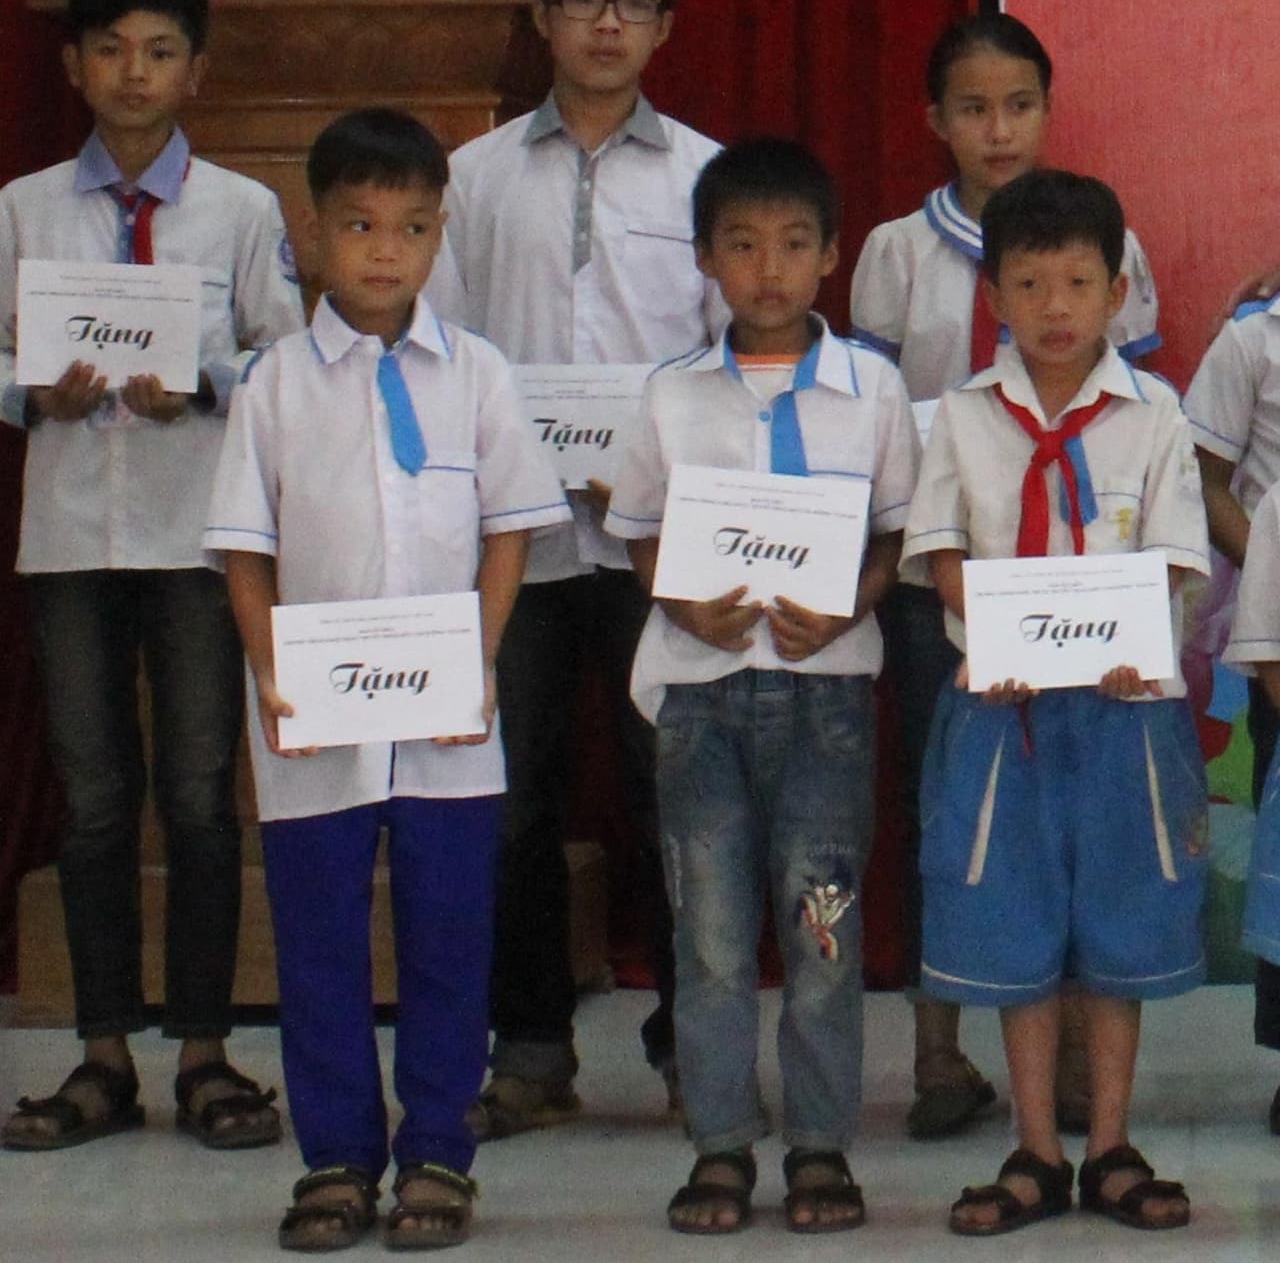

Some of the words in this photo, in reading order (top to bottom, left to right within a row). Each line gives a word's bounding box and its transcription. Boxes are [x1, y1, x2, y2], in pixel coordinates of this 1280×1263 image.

[65, 315, 154, 350] Tặng
[533, 418, 614, 451] Tặng
[713, 527, 810, 569] Tặng
[1020, 614, 1119, 647] Tặng
[330, 662, 430, 699] Tặng
